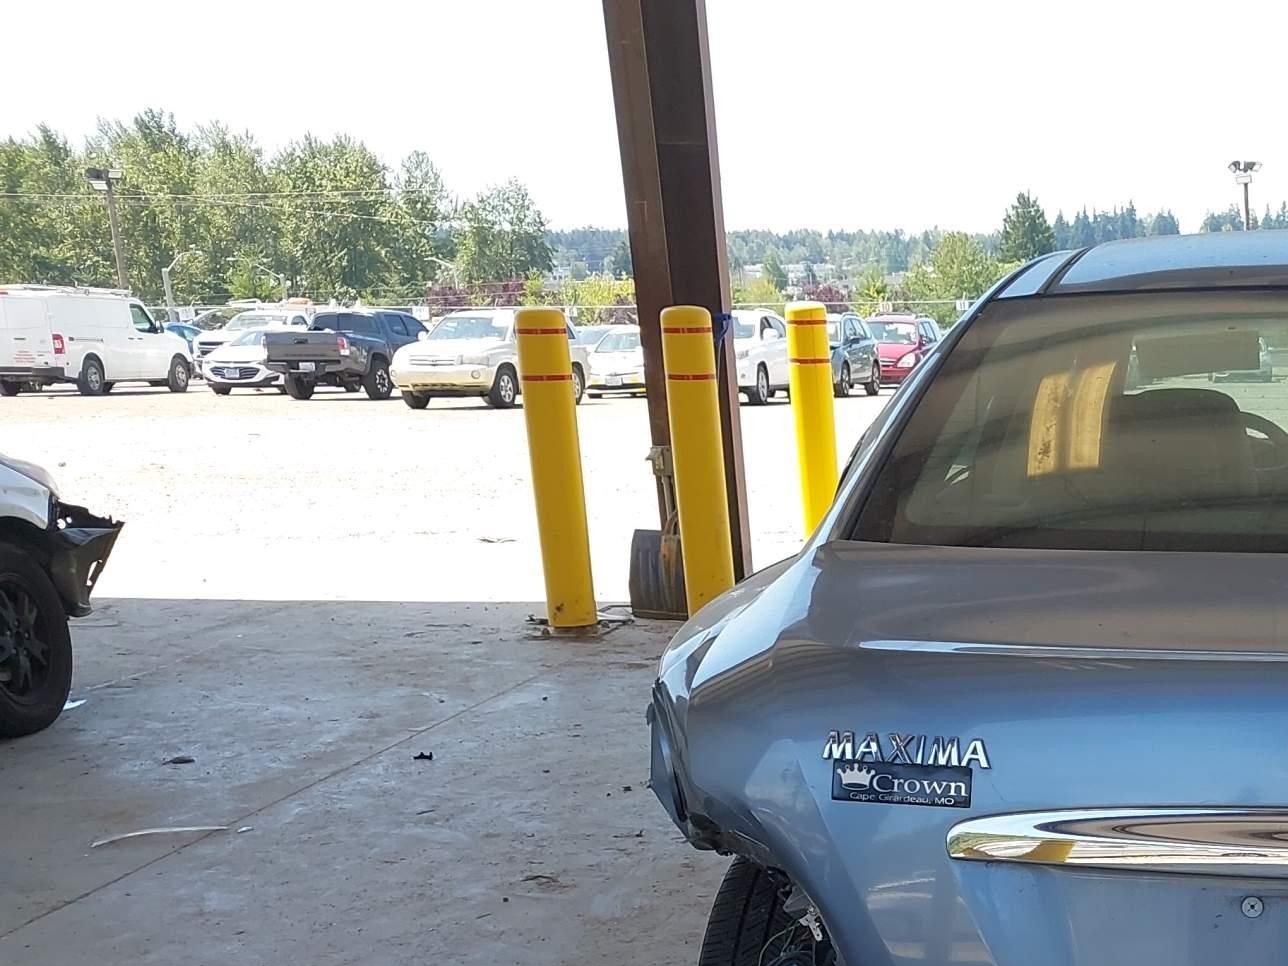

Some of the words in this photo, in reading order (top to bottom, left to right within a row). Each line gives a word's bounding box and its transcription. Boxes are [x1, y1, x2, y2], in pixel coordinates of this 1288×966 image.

[822, 730, 993, 769] MAXIMA
[872, 773, 969, 797] Crown
[849, 791, 876, 802] Cape
[934, 796, 955, 805] MO
